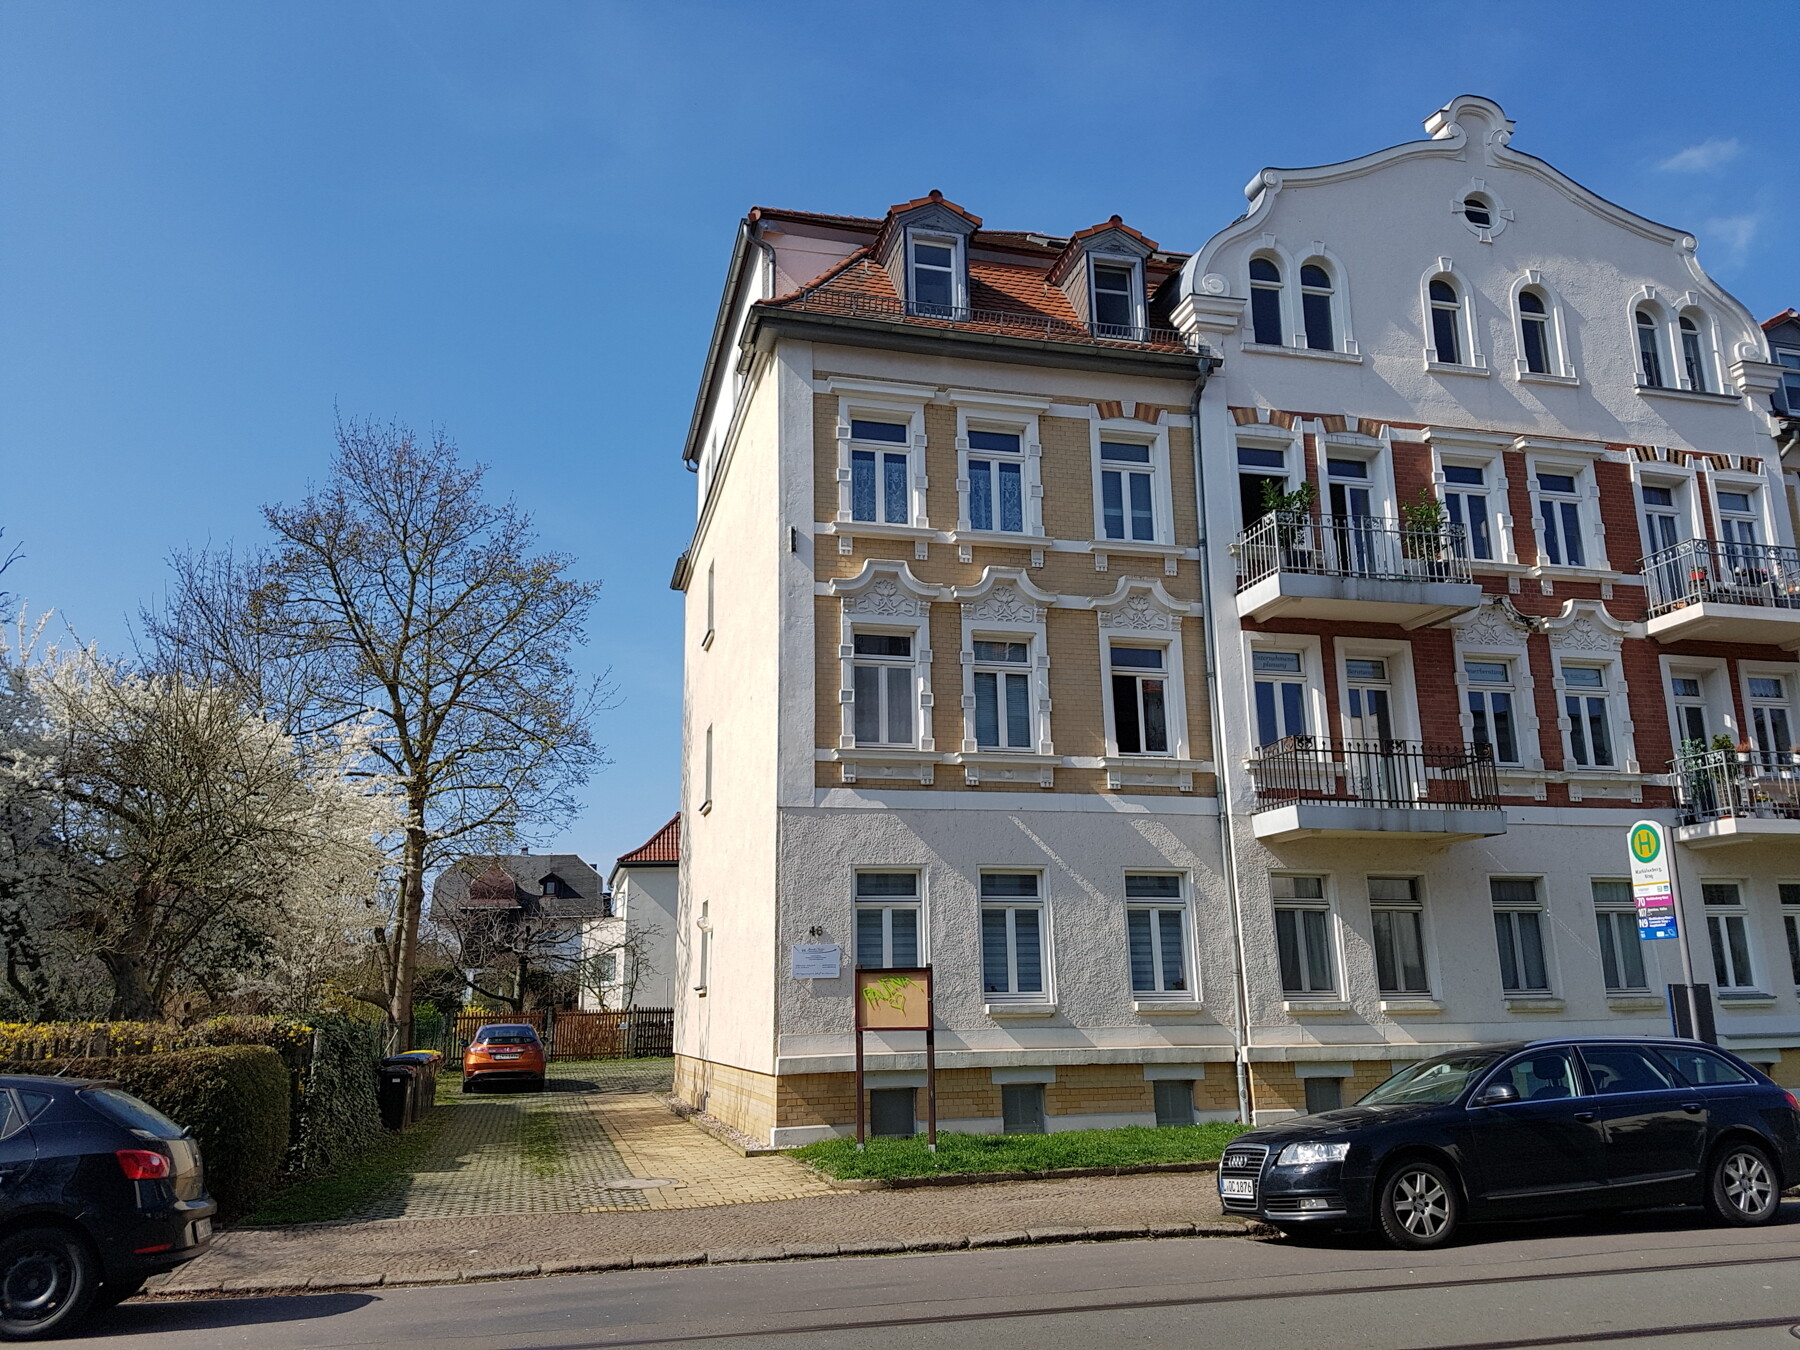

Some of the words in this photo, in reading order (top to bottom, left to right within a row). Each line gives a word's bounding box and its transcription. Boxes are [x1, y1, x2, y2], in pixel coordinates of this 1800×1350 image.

[1637, 832, 1652, 855] H
[1636, 897, 1646, 907] 70
[1638, 918, 1649, 928] N9
[809, 926, 823, 937] 46
[1236, 1181, 1252, 1193] 1876
